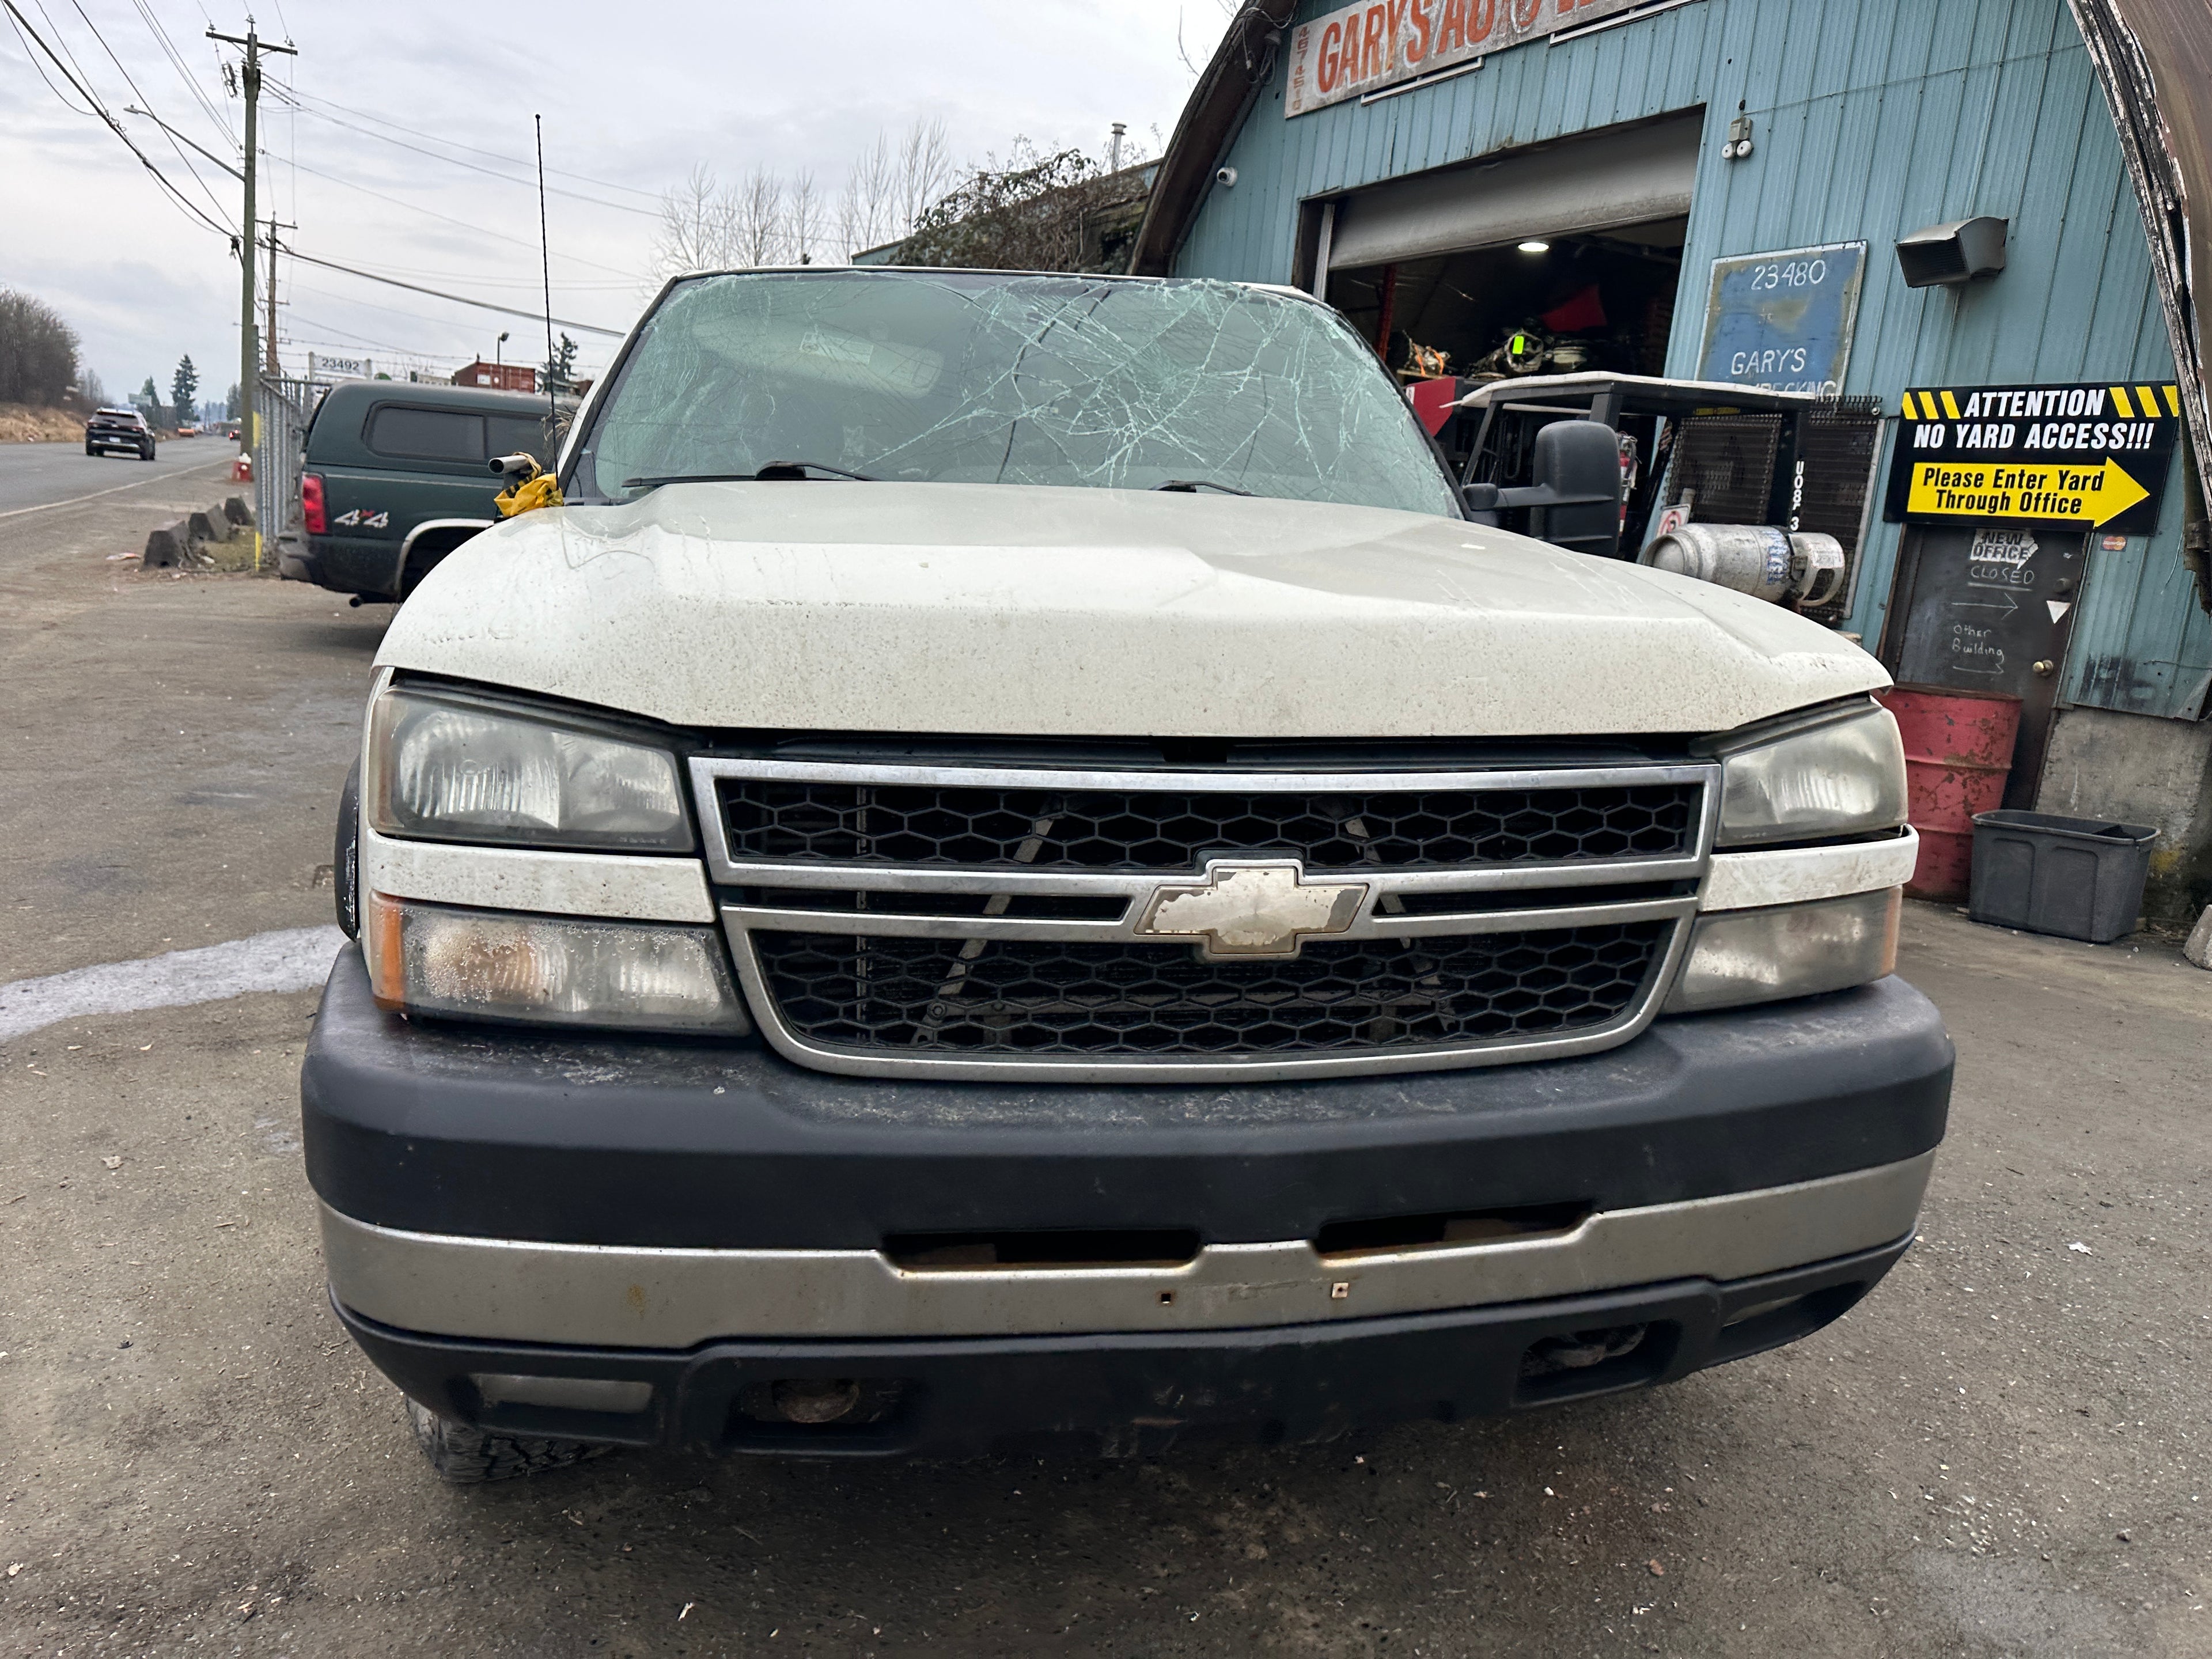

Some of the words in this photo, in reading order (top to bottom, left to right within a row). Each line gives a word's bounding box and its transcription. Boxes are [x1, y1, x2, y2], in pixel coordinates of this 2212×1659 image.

[1317, 0, 1433, 93] GARYS
[1751, 260, 1826, 290] 23480
[321, 358, 359, 371] 23492
[1731, 348, 1806, 374] GARY'S
[1964, 389, 2105, 417] ATTENTION
[1913, 423, 1945, 448] NO
[1956, 423, 2016, 448] YARD
[2024, 422, 2154, 449] ACCESS!!!
[1923, 467, 1984, 488] Please
[1993, 469, 2047, 490] Enter
[2058, 470, 2105, 491] Yard
[1936, 490, 2010, 514] Through
[2019, 491, 2082, 514] Office
[1972, 543, 2030, 560] OFFICE
[1952, 637, 2005, 665] Building
